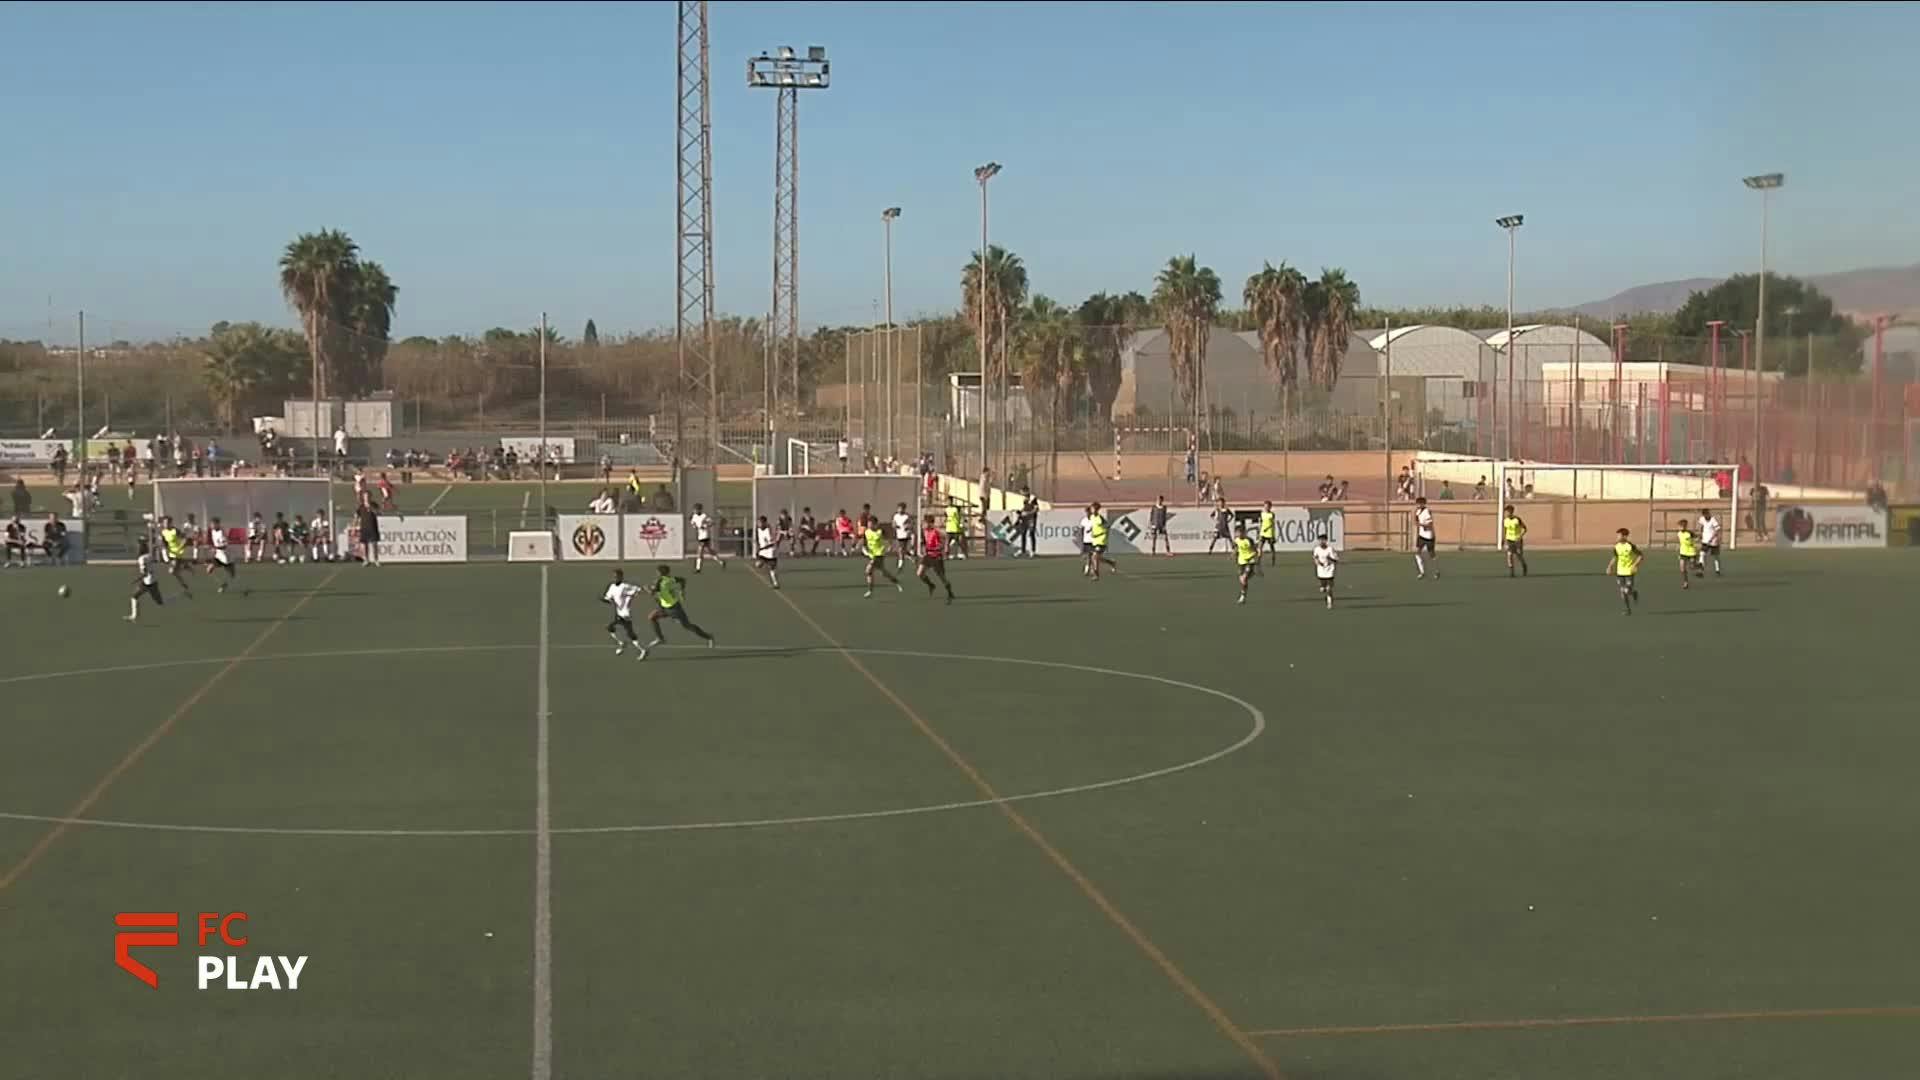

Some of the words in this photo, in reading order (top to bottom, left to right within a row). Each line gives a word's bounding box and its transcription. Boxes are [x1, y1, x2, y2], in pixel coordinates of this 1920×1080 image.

[380, 529, 457, 542] DIPUTACIÓN
[1273, 519, 1337, 544] XCABOL
[1816, 522, 1881, 540] RAMAL
[379, 543, 396, 555] DE
[398, 542, 455, 555] ALMERÍA
